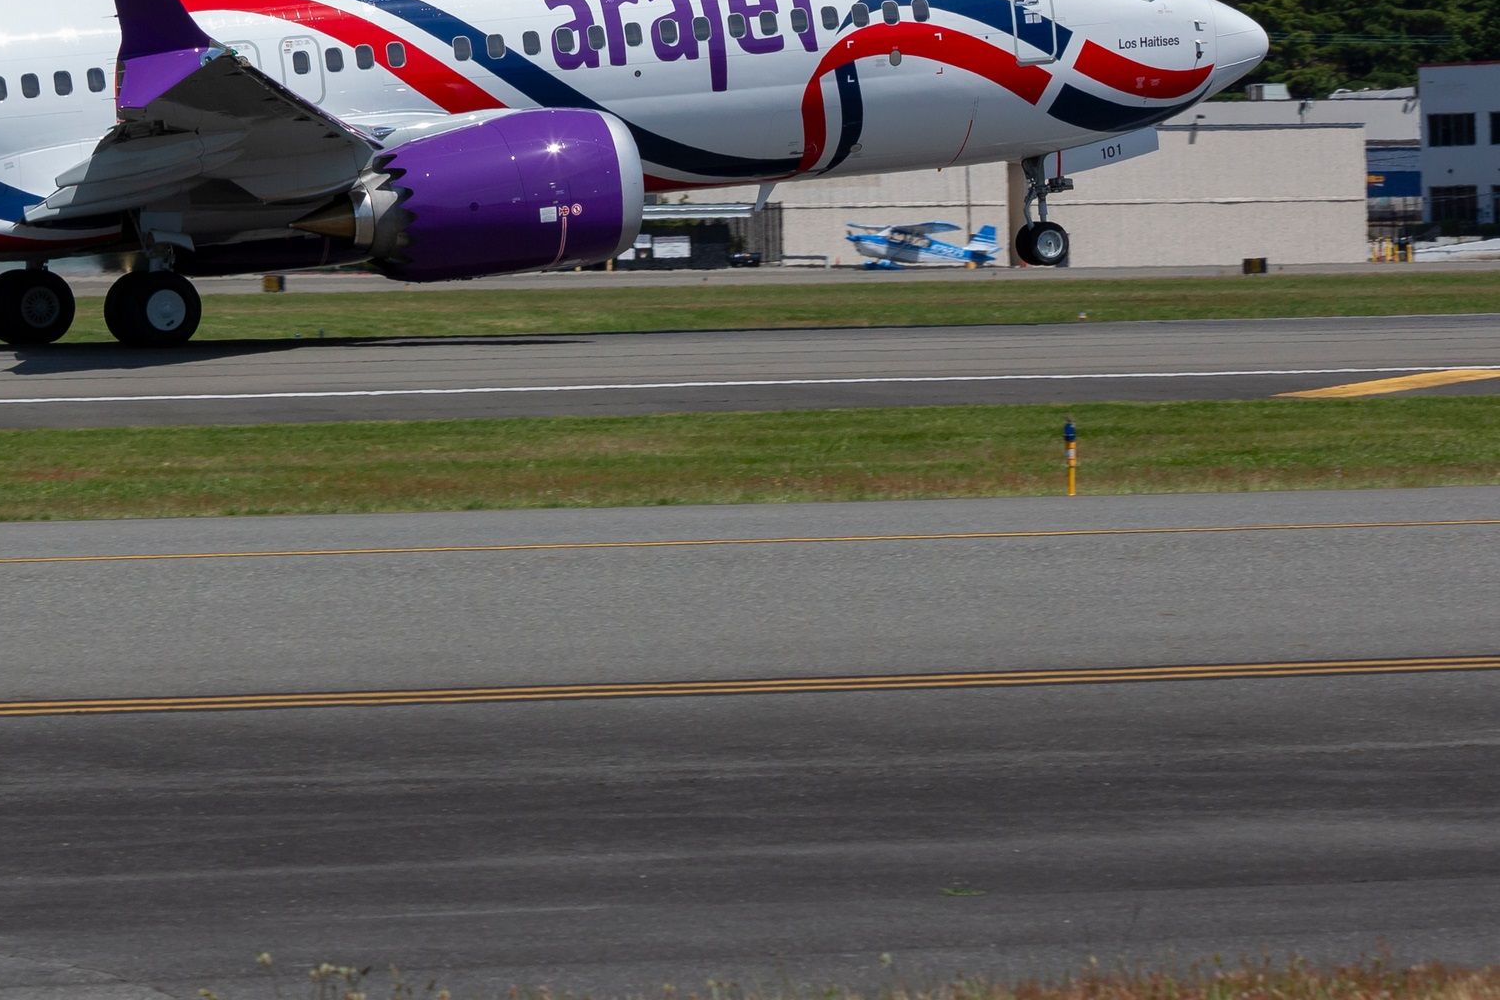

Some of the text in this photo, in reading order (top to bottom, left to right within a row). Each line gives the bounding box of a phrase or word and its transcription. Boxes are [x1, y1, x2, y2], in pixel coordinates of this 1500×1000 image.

[1119, 36, 1180, 49] Los Haitises
[1101, 143, 1122, 159] 101
